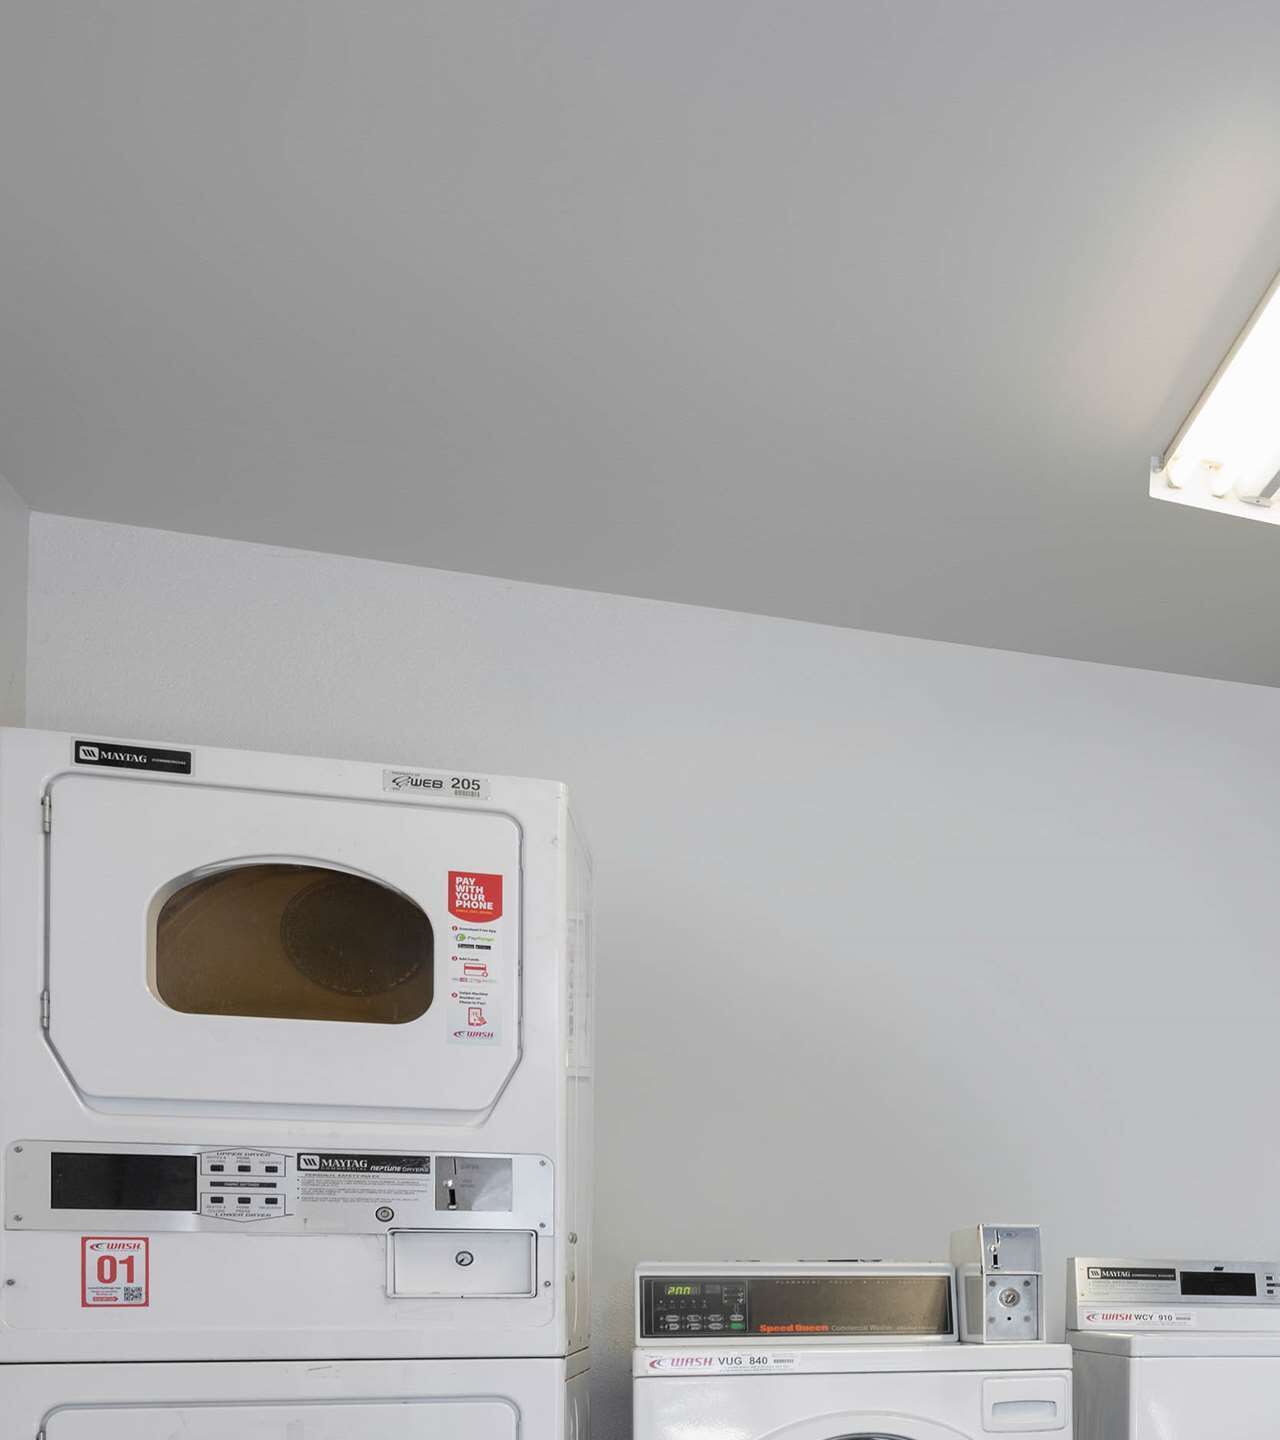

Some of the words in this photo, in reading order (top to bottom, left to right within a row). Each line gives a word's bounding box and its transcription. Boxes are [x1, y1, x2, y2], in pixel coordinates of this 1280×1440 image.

[101, 751, 147, 763] MAYTAG
[410, 778, 443, 789] WEB
[451, 777, 480, 791] 205
[455, 876, 476, 886] PAY
[455, 884, 484, 894] WITH
[455, 892, 485, 902] YOUR
[455, 900, 494, 910] PHONE
[320, 1159, 368, 1168] MAYTAG
[97, 1255, 134, 1284] 01
[1102, 1270, 1131, 1278] MAYTAG
[760, 1324, 793, 1333] Speed
[718, 1357, 743, 1366] VUG
[749, 1356, 768, 1365] 840
